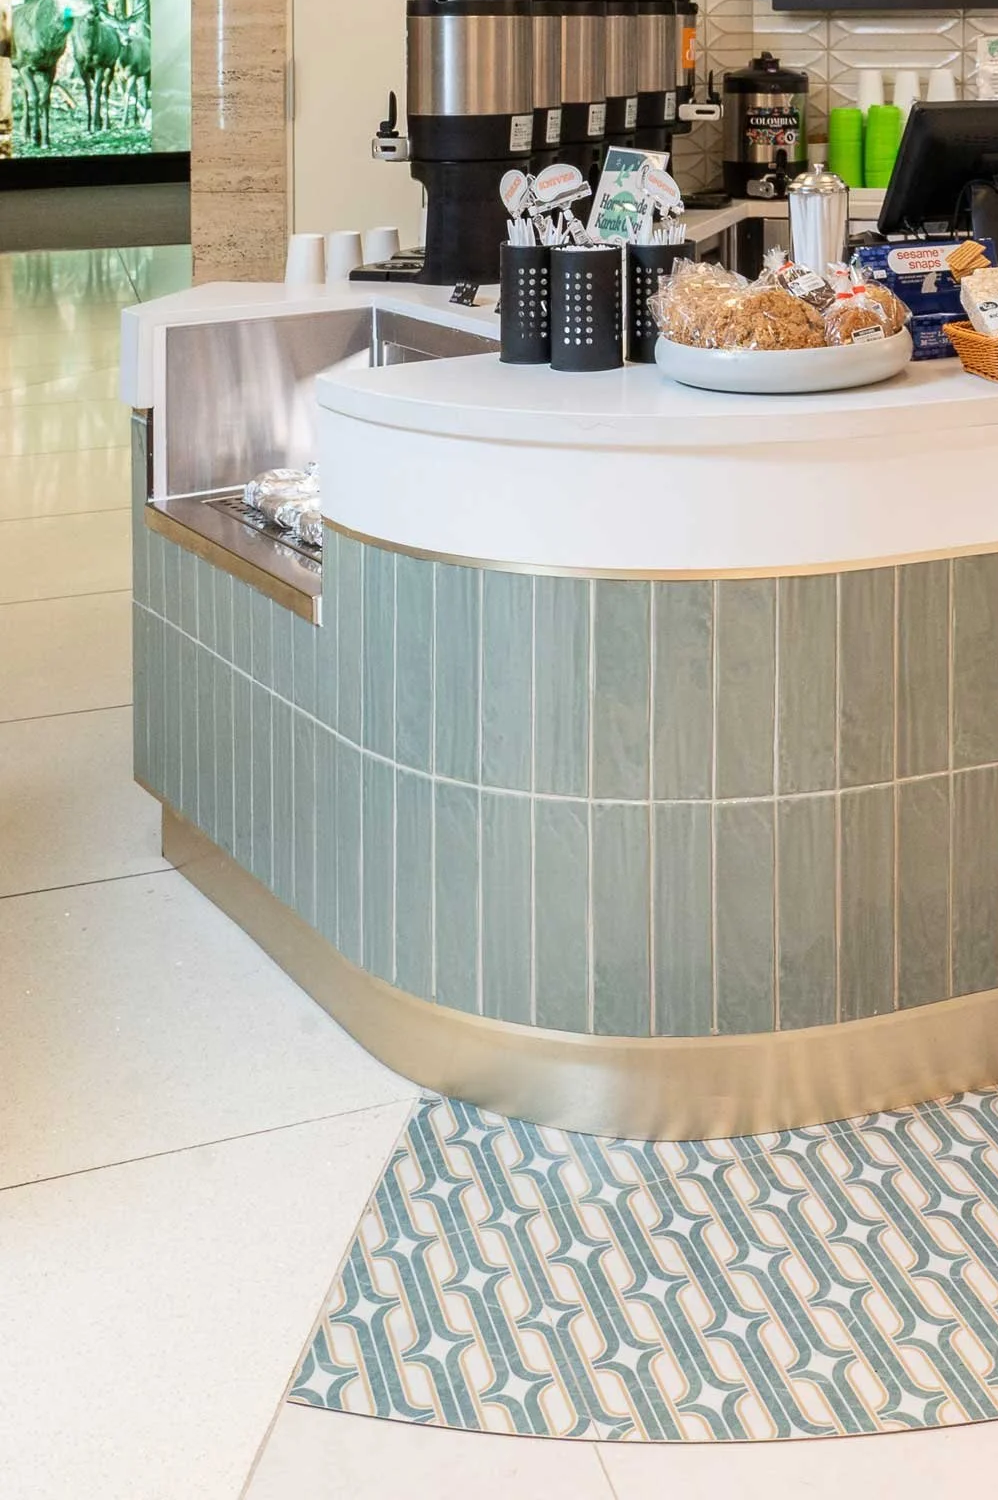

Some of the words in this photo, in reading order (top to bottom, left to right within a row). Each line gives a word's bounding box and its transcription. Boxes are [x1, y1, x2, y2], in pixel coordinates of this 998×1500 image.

[750, 116, 797, 126] COLOMBIAN
[896, 249, 939, 260] sesame
[908, 259, 942, 270] snaps
